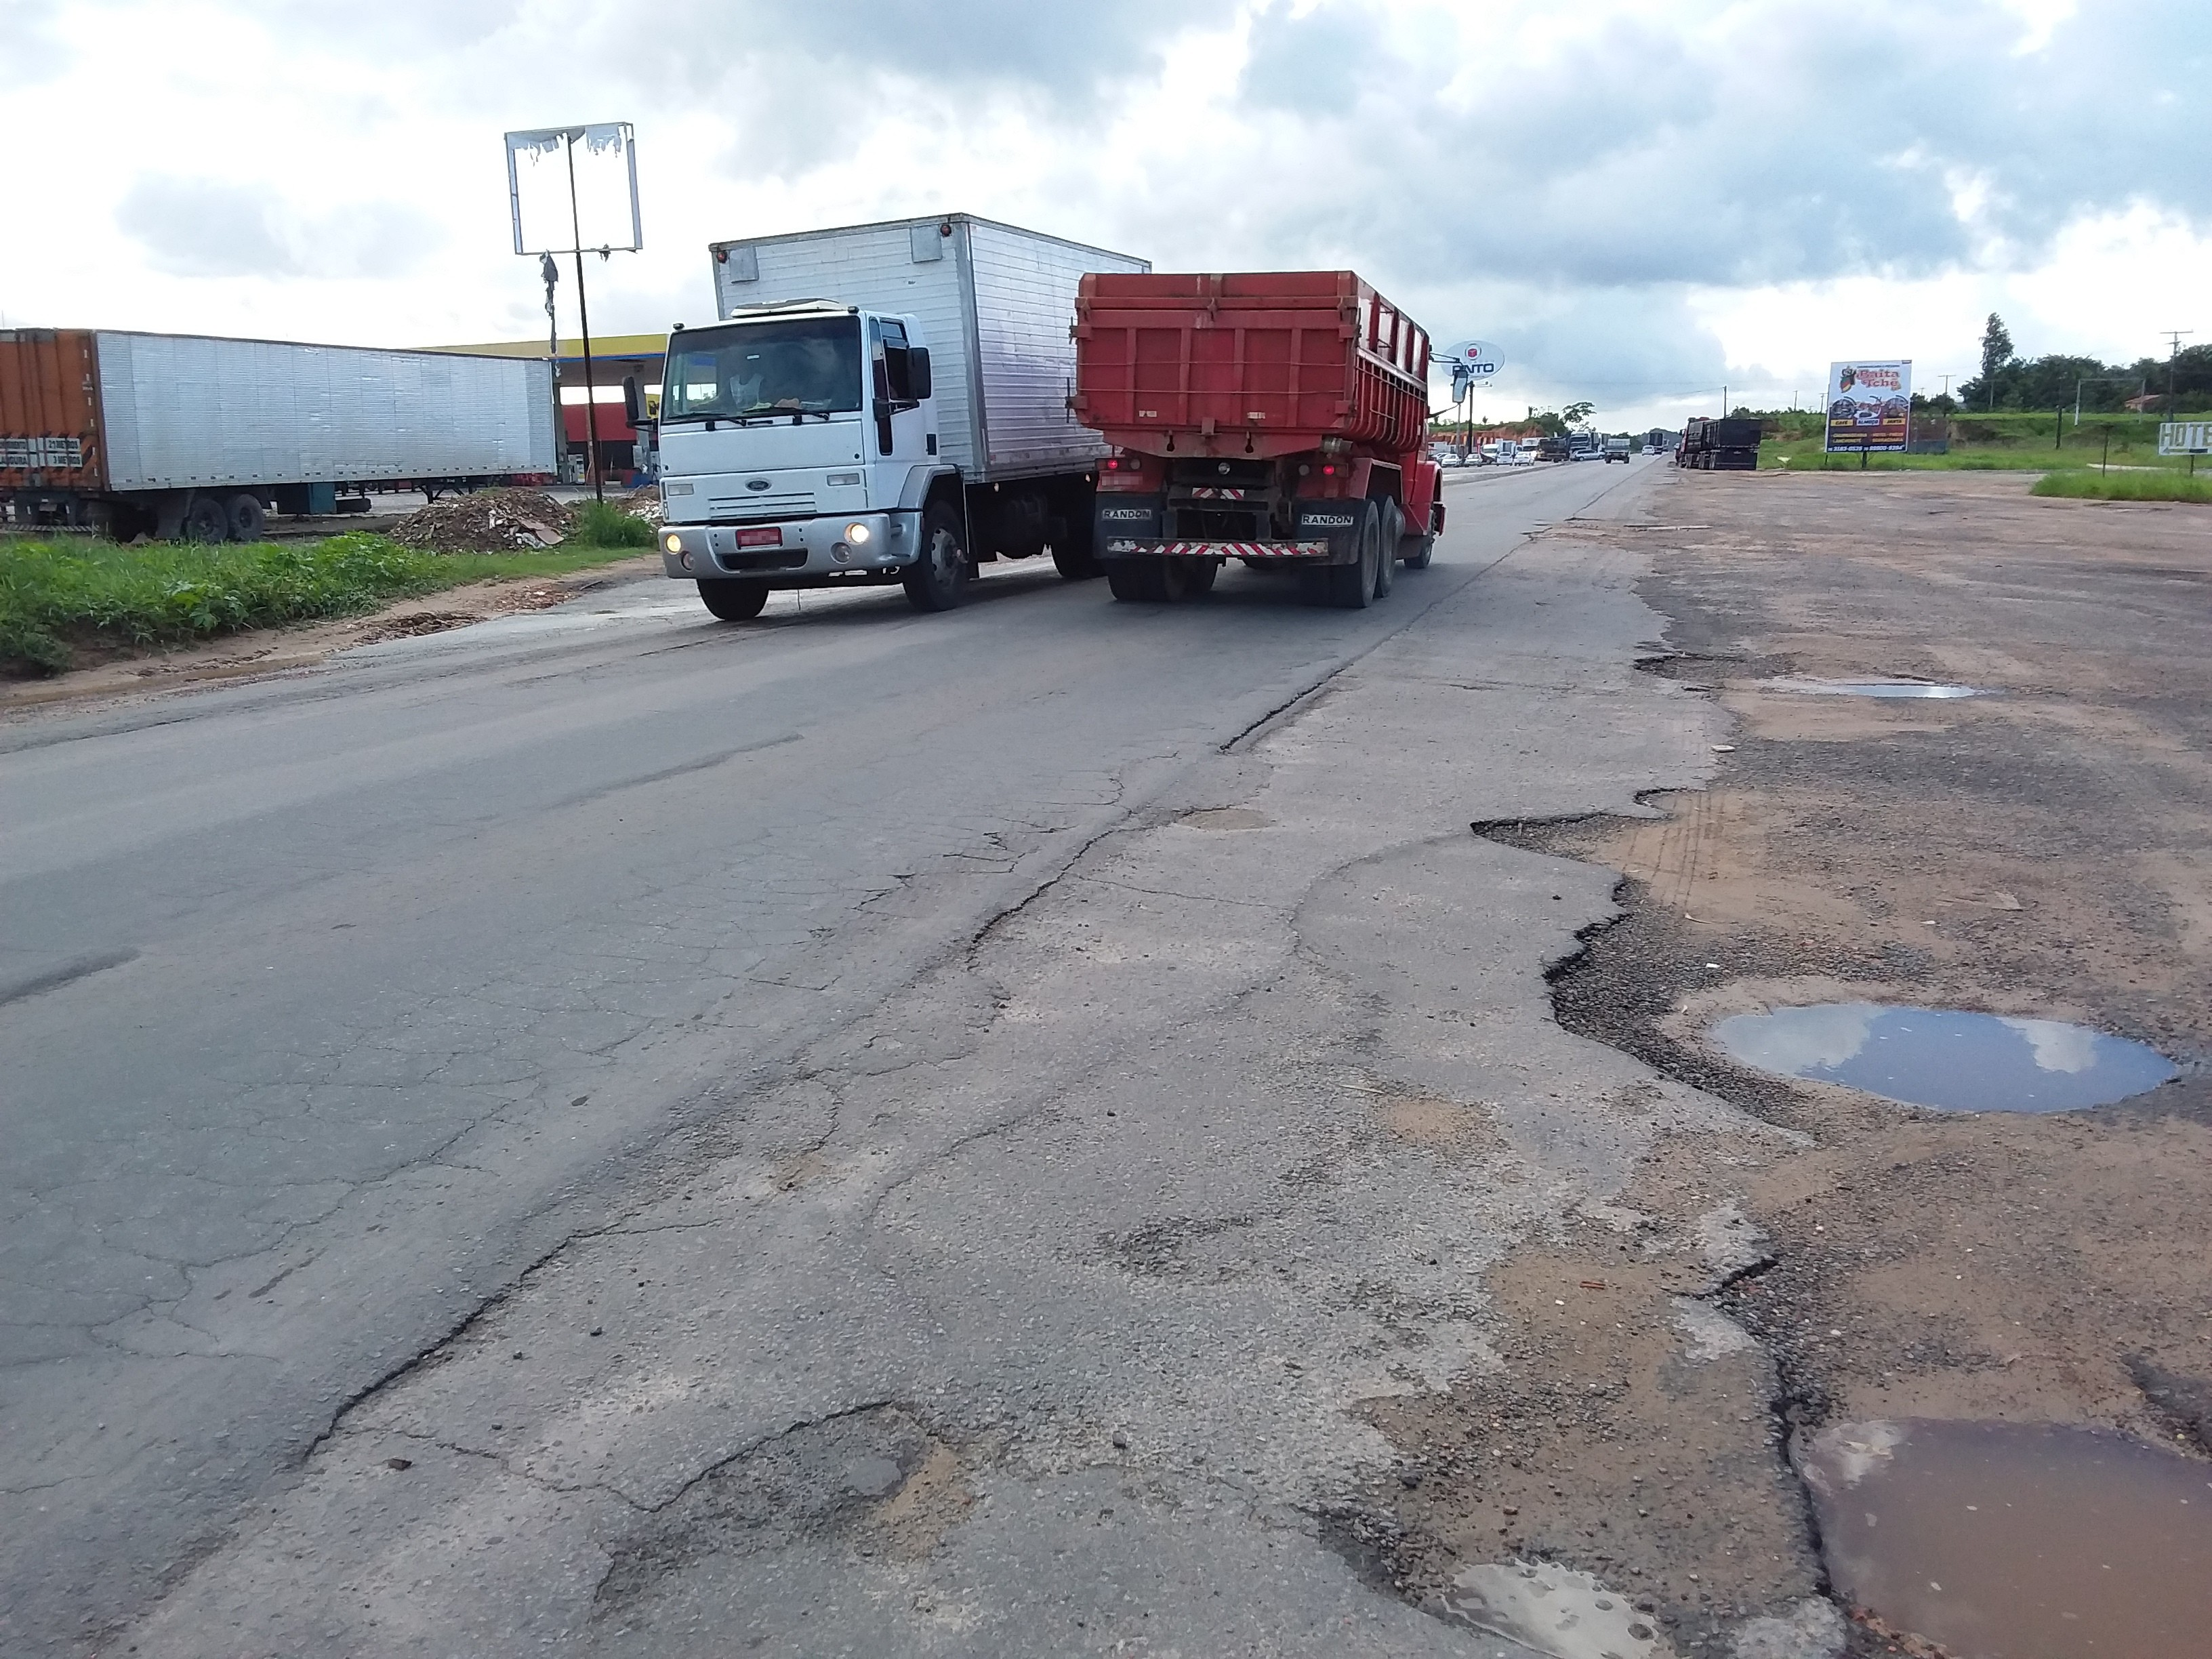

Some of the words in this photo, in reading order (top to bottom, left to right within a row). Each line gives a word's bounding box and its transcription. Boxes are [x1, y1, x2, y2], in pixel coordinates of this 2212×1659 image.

[1858, 370, 1899, 379] Baita
[1104, 510, 1150, 518] RANDON
[1303, 515, 1351, 524] RANDON
